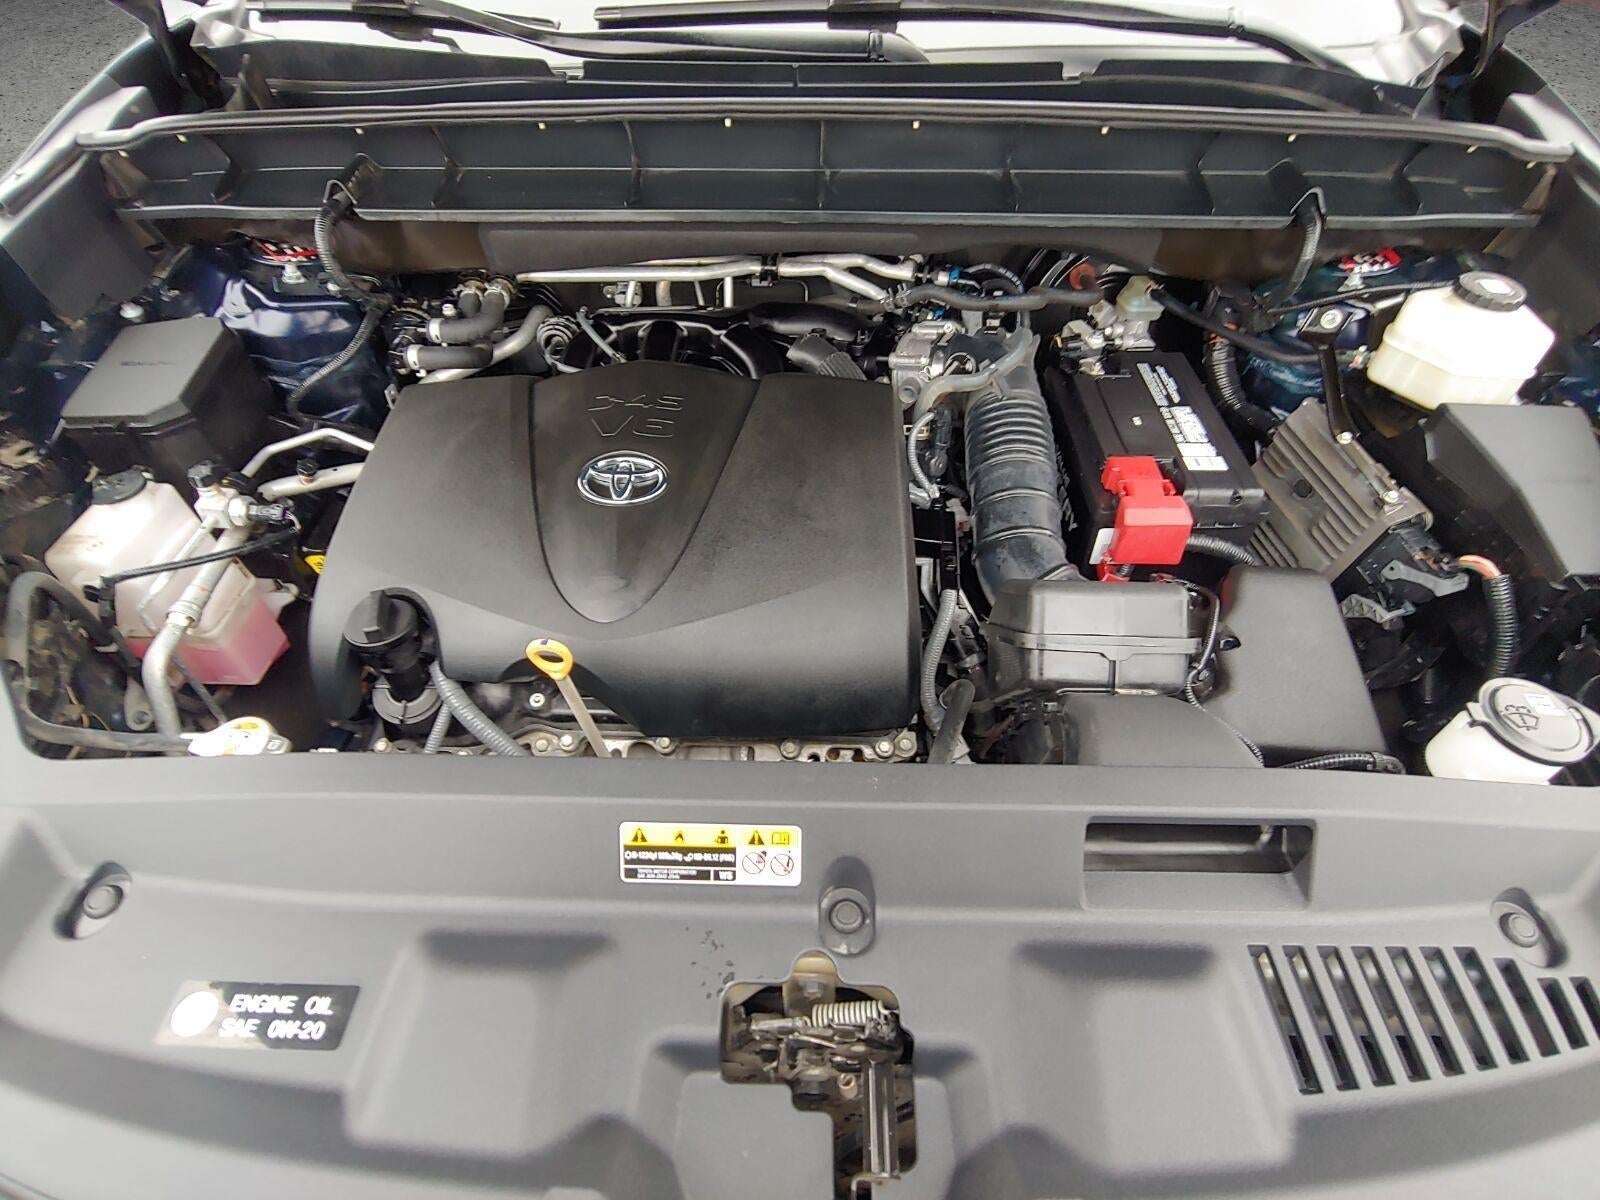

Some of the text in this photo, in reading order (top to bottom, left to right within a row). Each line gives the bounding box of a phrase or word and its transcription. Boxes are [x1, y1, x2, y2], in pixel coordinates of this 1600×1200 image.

[229, 994, 334, 1016] ENGINE OIL
[218, 1018, 327, 1040] SAE 0W-20
